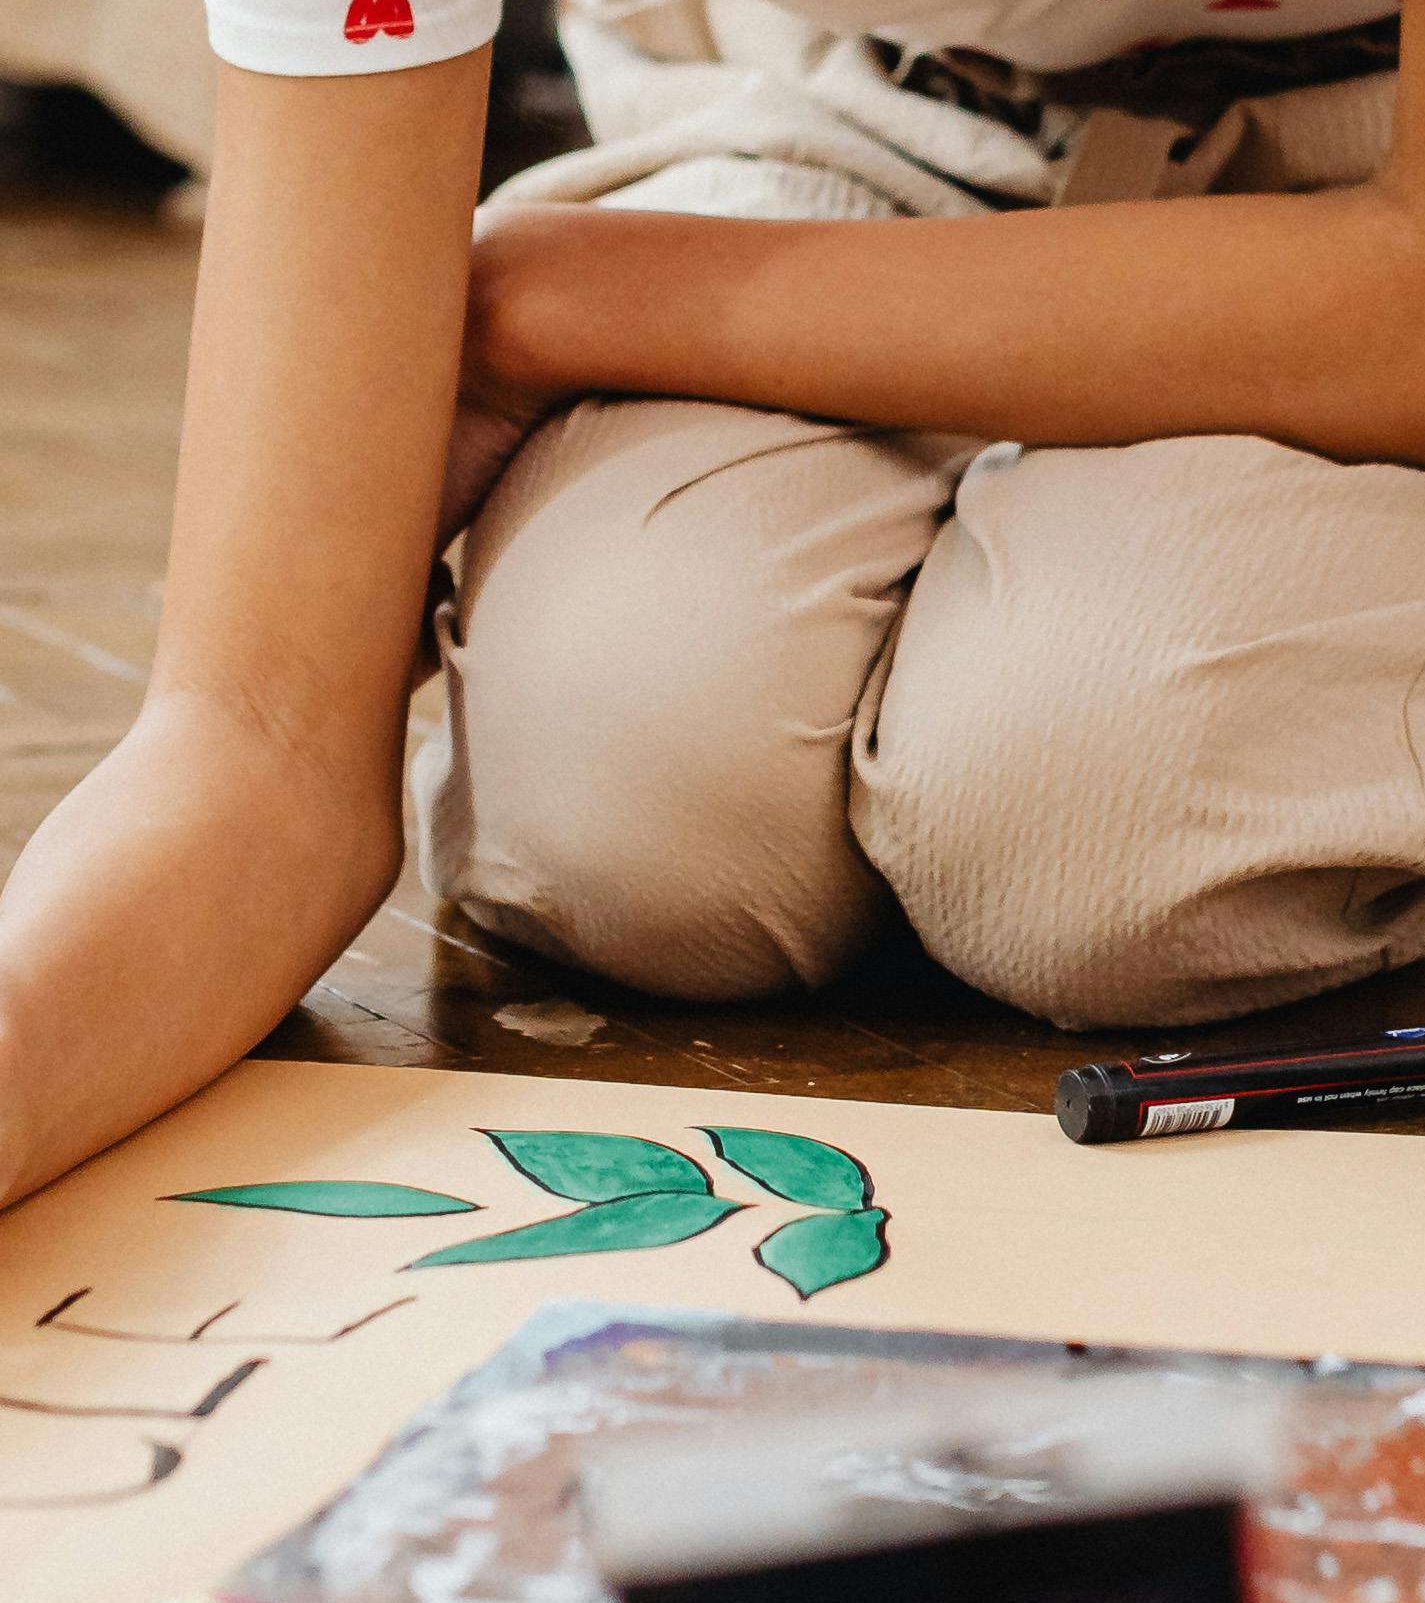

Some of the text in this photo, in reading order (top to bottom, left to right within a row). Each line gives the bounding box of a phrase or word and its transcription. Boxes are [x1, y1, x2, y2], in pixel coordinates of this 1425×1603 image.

[1364, 1088, 1388, 1097] firmly
[1388, 1085, 1404, 1095] cap
[1324, 1093, 1339, 1102] not
[1339, 1091, 1362, 1099] when
[1297, 1096, 1313, 1104] use
